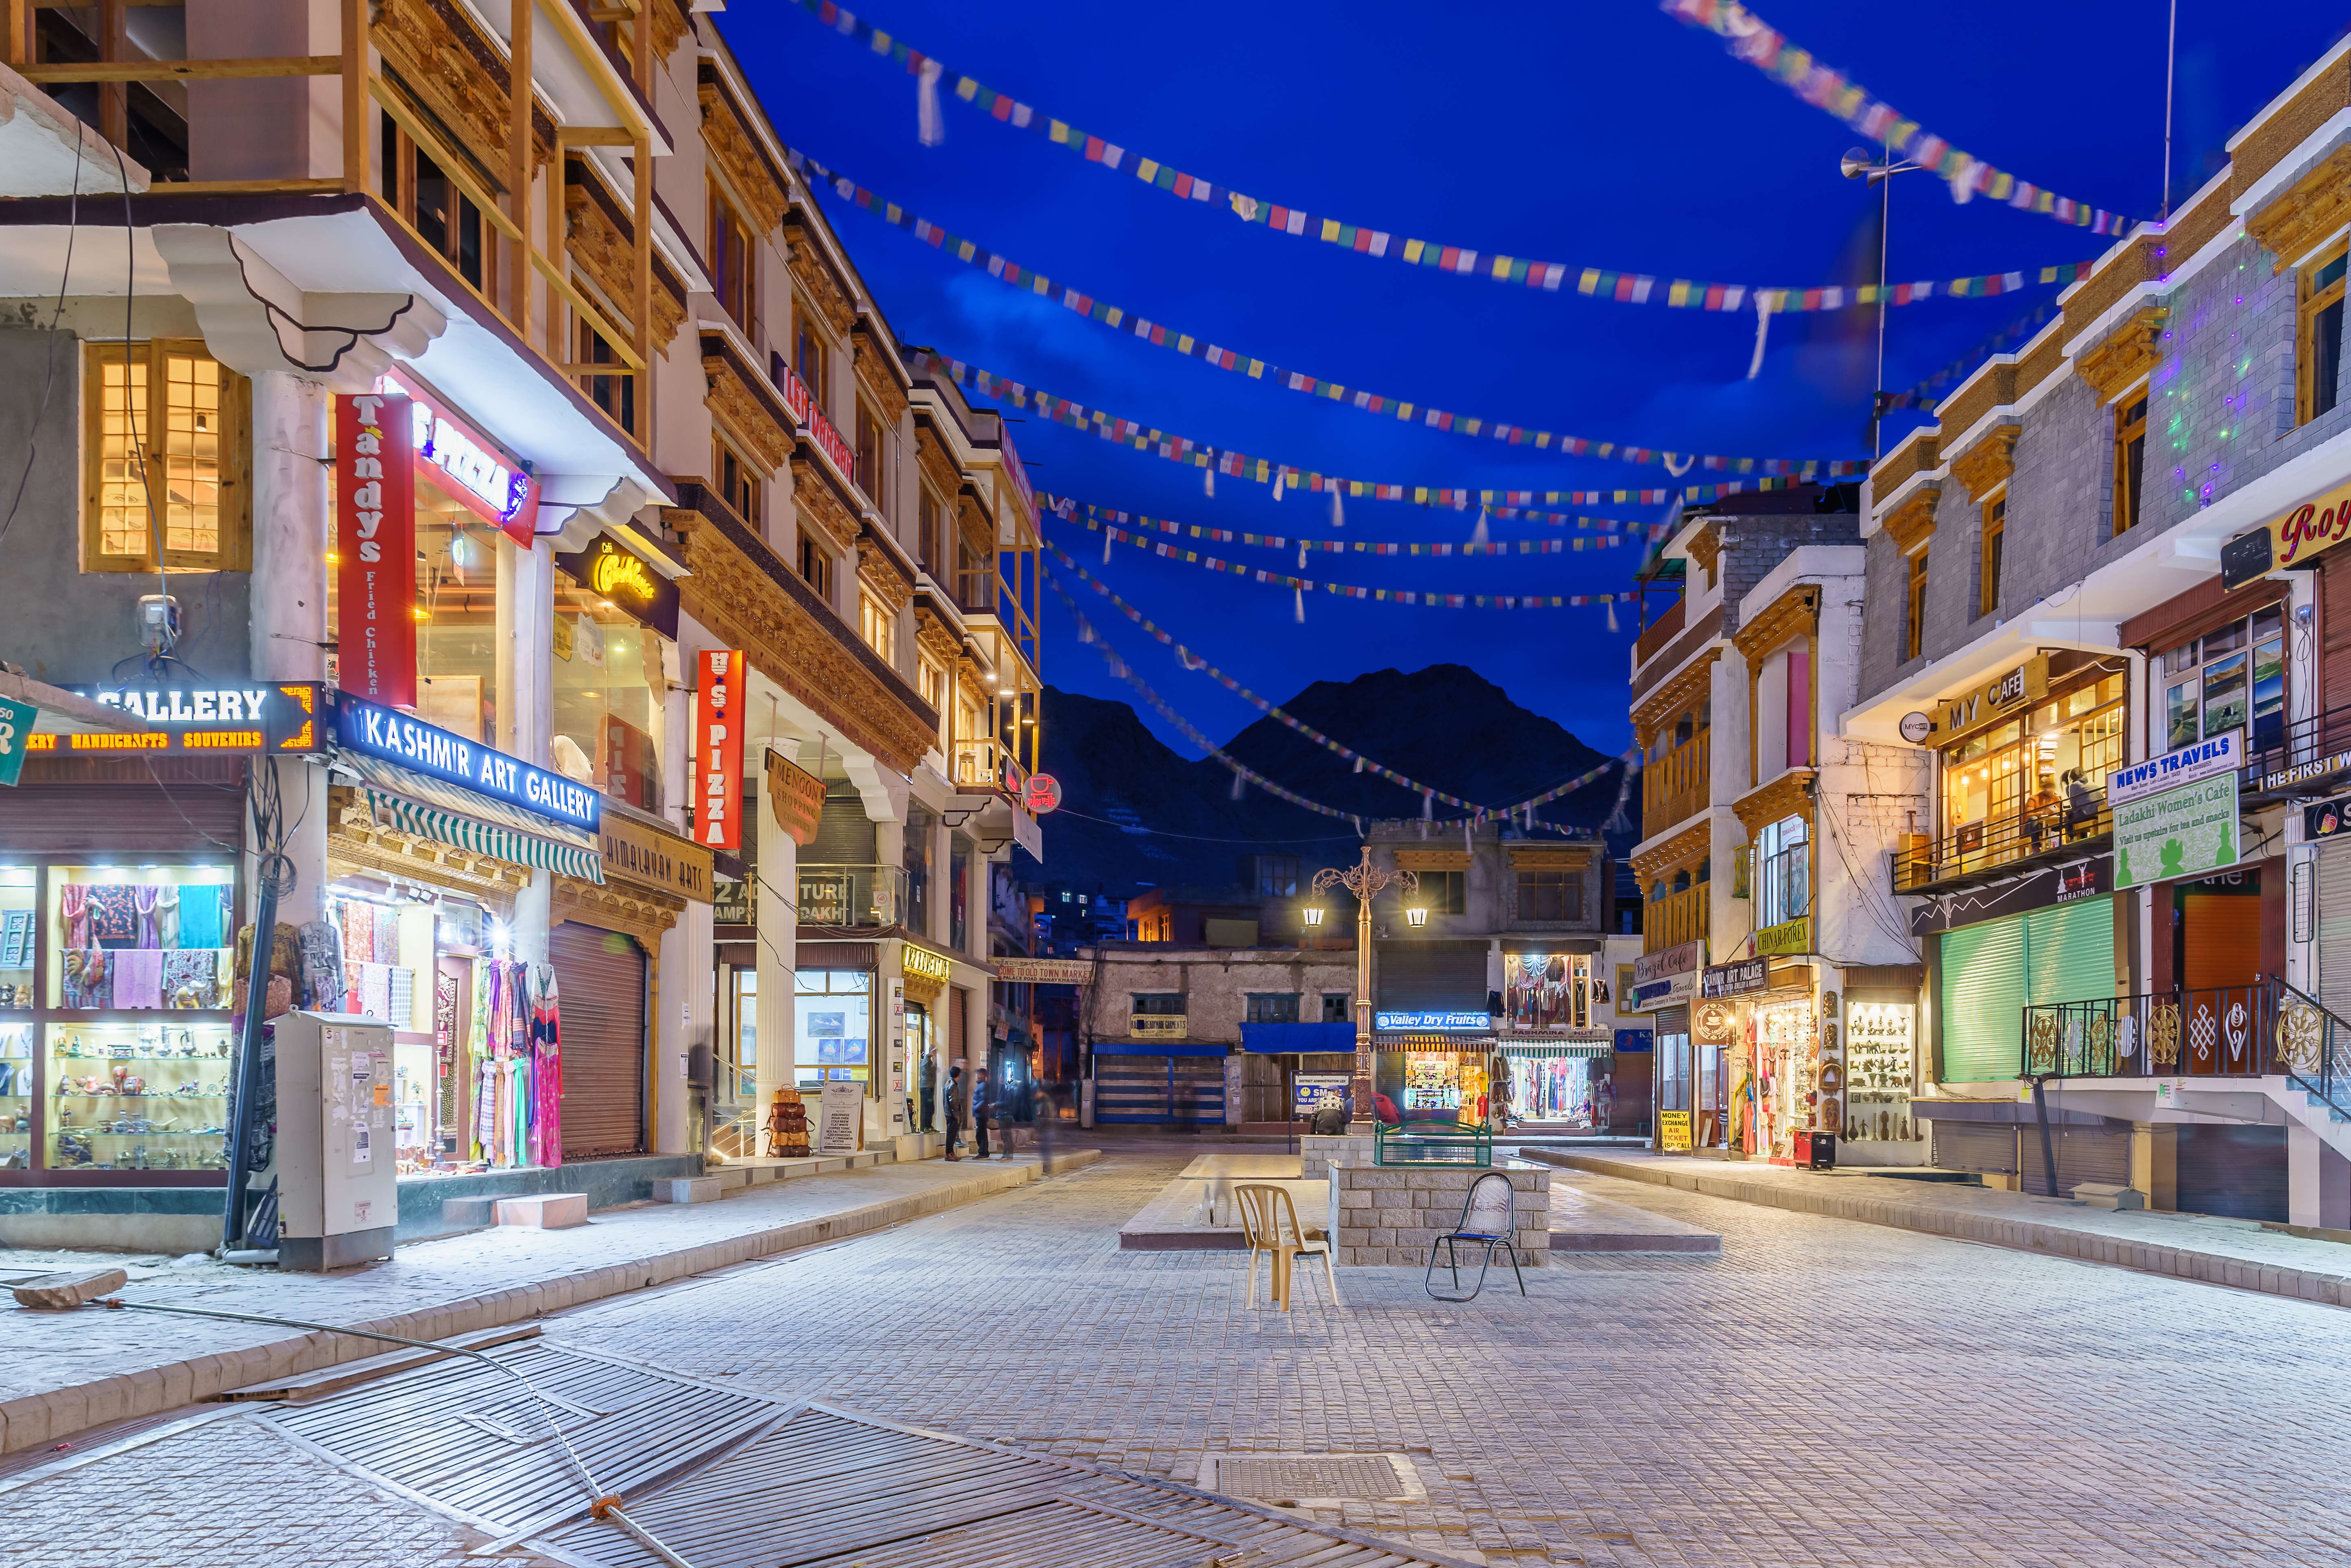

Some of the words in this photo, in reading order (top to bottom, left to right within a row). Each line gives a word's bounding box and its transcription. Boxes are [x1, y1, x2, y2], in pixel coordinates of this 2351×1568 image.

[784, 367, 808, 422] LEH
[809, 401, 853, 484] DARBAR
[352, 396, 384, 563] Tandys
[433, 417, 510, 512] PIZZA
[367, 572, 376, 620] Fried
[365, 627, 378, 695] Chicken
[1950, 694, 1980, 730] MY
[1988, 666, 2024, 705] CAFÉ
[72, 733, 168, 749] HANDICRAFTS
[183, 732, 262, 747] SOUVENIRS
[365, 709, 471, 777] KASHMIR
[480, 754, 517, 793] ART
[526, 772, 594, 821] GALLERY
[2117, 762, 2157, 788] NEWS
[2160, 737, 2229, 773] TRAVELS
[2290, 757, 2333, 782] FIRST
[707, 725, 727, 844] PIZZA
[777, 788, 816, 819] SHOPPING
[2119, 804, 2155, 827] Ladakhi
[2205, 783, 2229, 801] Cafe
[784, 812, 811, 833] COMPLEX
[2119, 835, 2133, 845] Visit
[2143, 827, 2168, 841] upstairs
[2169, 823, 2179, 833] for
[2181, 821, 2190, 830] tea
[2192, 815, 2204, 826] and
[2206, 808, 2229, 823] snacks
[607, 836, 671, 882] HIMALAYAN
[679, 862, 702, 892] ARTS
[2057, 887, 2095, 902] MARATHON
[714, 906, 755, 919] AMPS
[1758, 930, 1782, 950] CHINAR
[1783, 922, 1806, 944] FOREX
[998, 967, 1015, 976] COME
[1017, 967, 1024, 976] TO
[1040, 969, 1059, 977] TOWN
[1063, 970, 1091, 978] MARKET
[1637, 952, 1666, 980] Brazil
[1727, 969, 1738, 983] ART
[1740, 964, 1762, 981] PALACE
[1673, 977, 1694, 993] travels
[1165, 1020, 1186, 1029] GARMENTS
[1390, 1015, 1421, 1025] Valley
[1423, 1015, 1443, 1025] Dry
[1446, 1015, 1476, 1024] Fruits
